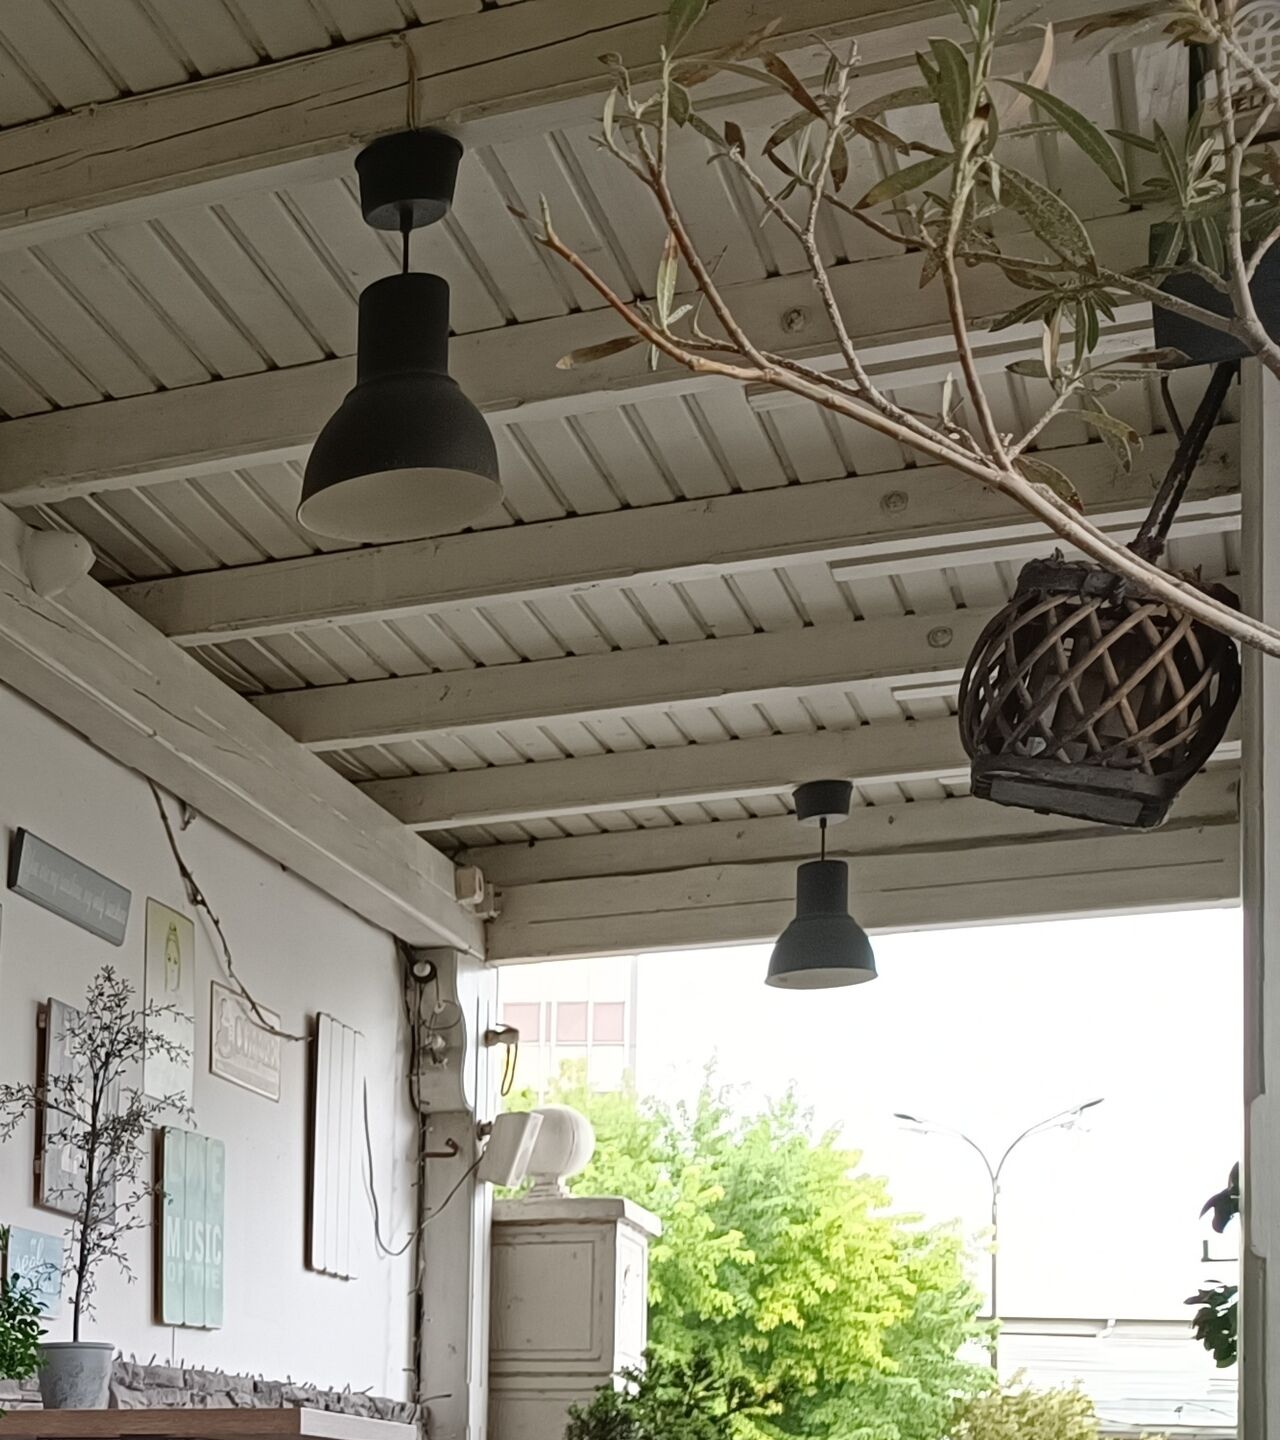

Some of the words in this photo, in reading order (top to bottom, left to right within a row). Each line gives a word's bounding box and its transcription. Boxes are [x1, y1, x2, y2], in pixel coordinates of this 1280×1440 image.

[166, 1215, 223, 1266] MUSIC
[167, 1260, 184, 1284] OF
[192, 1263, 221, 1290] THE
